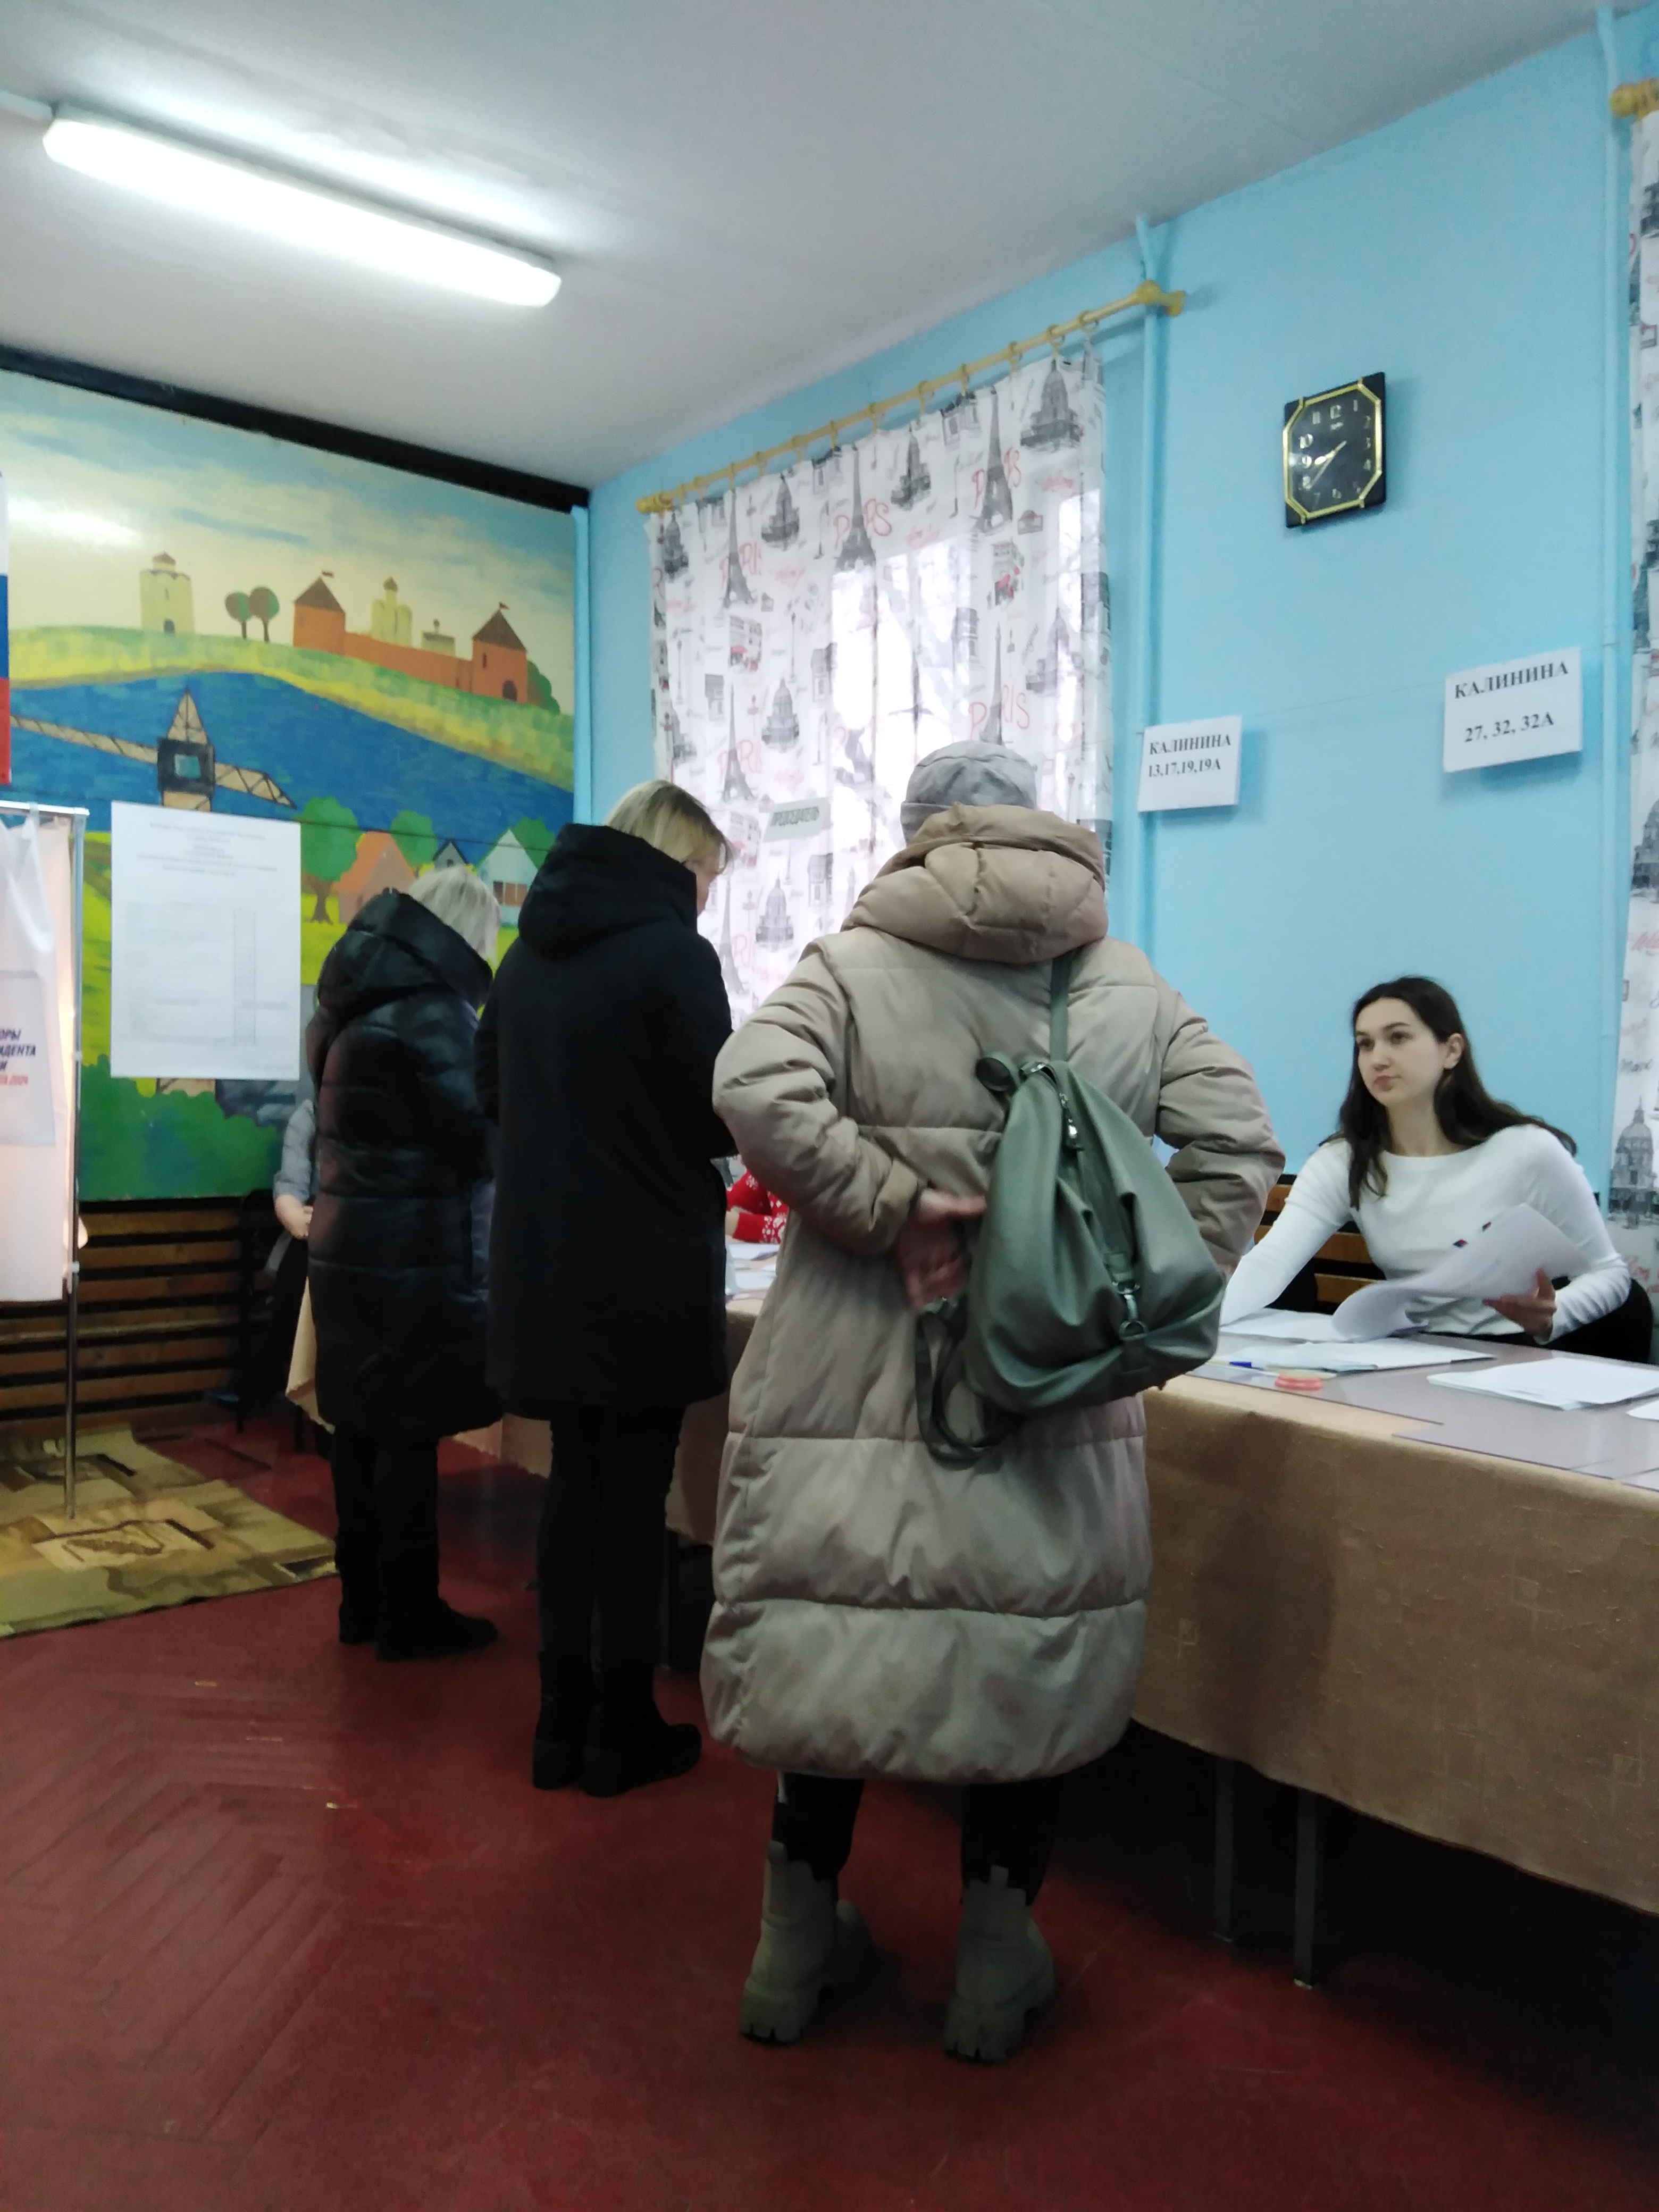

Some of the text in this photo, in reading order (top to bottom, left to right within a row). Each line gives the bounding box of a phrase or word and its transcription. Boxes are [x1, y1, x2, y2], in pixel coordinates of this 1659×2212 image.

[1455, 661, 1568, 699] КАЛИНИНА
[1520, 711, 1554, 732] 32А
[1150, 734, 1231, 755] КАЛИНИНА
